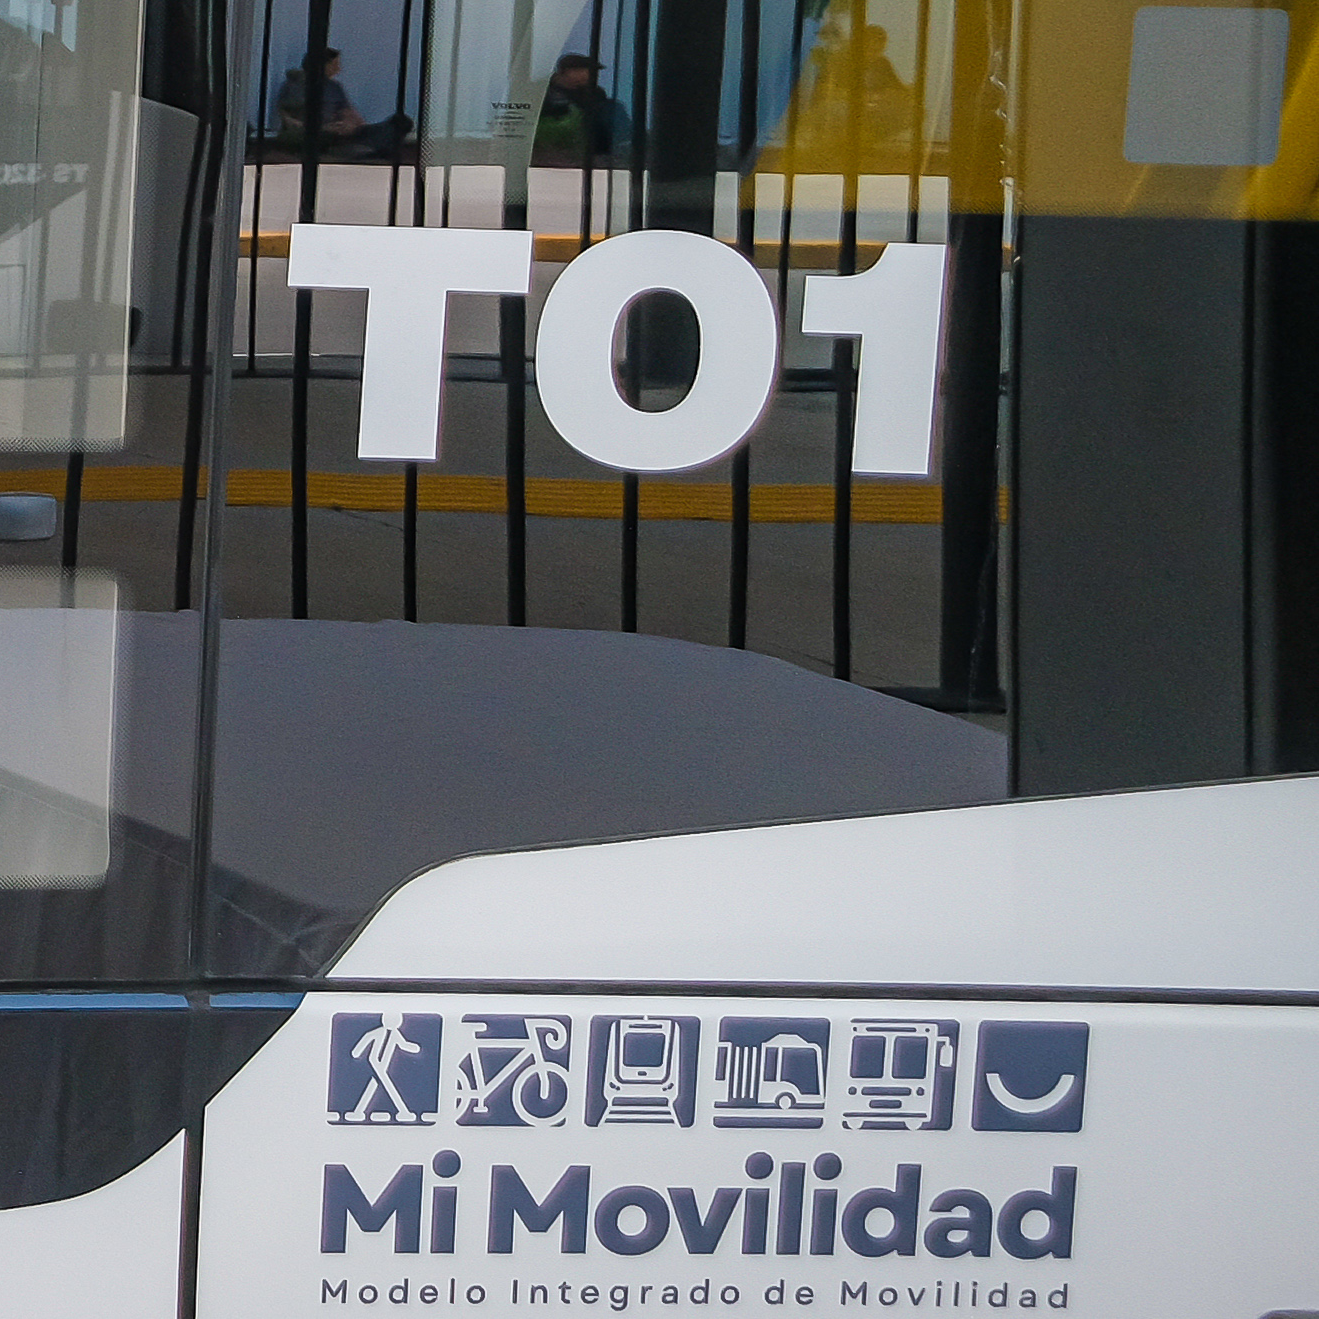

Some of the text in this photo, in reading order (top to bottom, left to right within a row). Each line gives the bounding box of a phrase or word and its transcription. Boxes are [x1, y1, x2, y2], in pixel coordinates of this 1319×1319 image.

[491, 102, 531, 110] VOLVO
[320, 1149, 1077, 1260] Mi Movilidad
[321, 1278, 1068, 1311] Modelo Integrado de Movilidad
